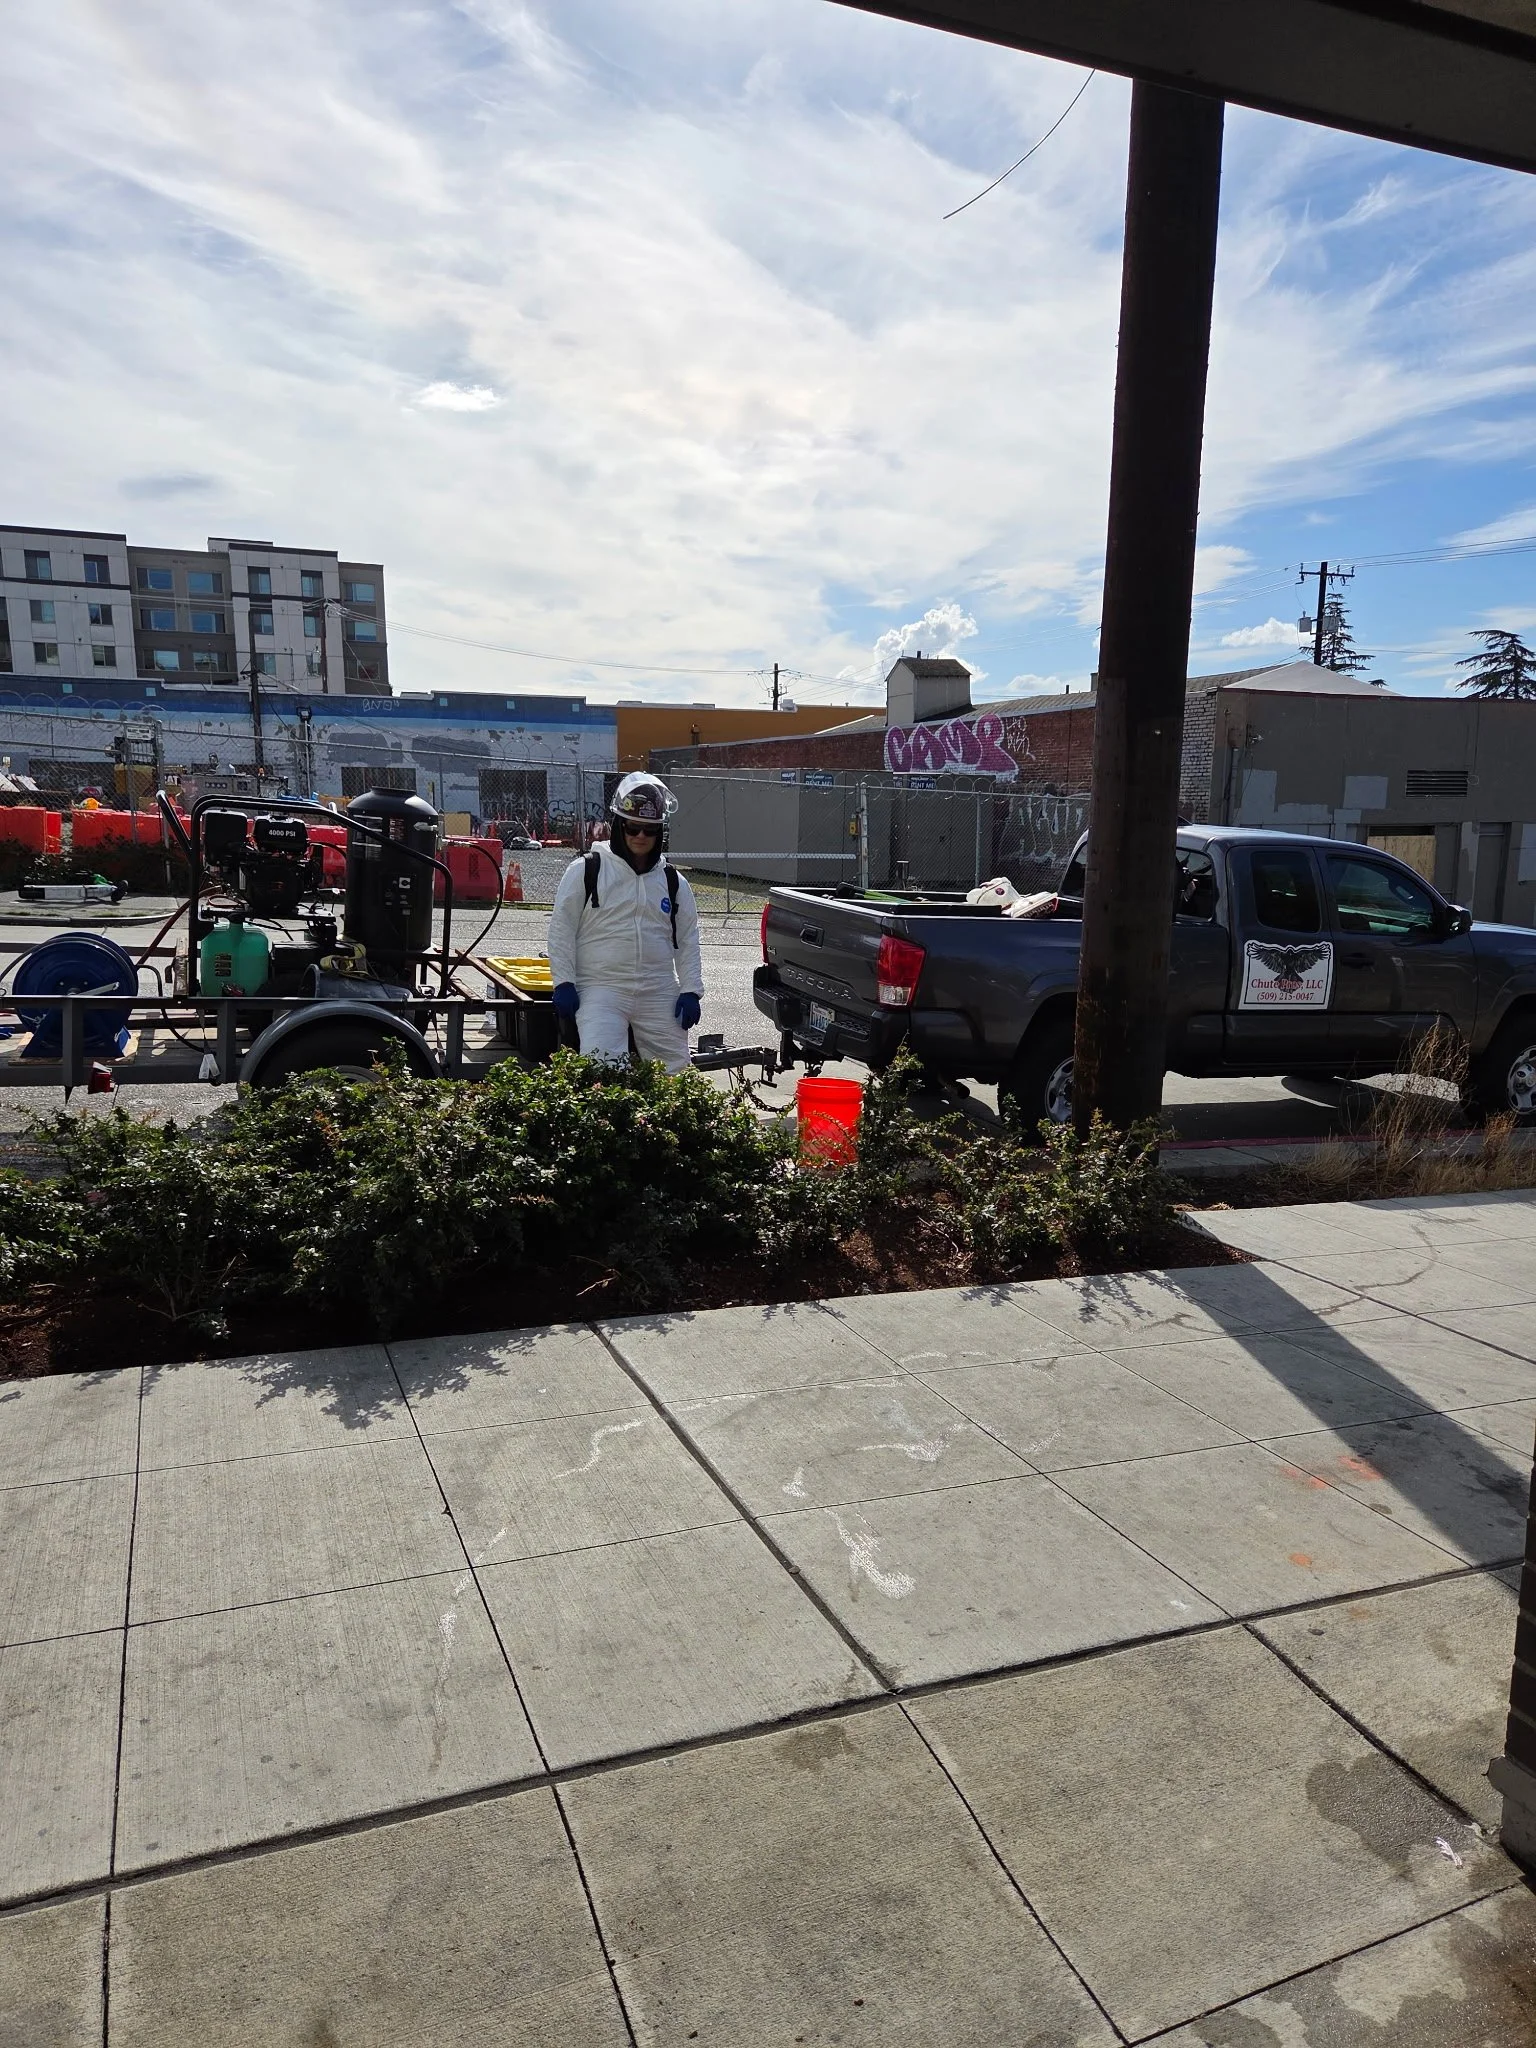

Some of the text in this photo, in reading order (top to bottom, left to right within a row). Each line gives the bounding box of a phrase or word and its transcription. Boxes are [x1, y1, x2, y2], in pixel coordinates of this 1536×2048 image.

[786, 968, 852, 1000] TACOMA
[1251, 979, 1279, 989] Chute
[1306, 980, 1323, 989] LLC
[1256, 991, 1277, 1001] (509)
